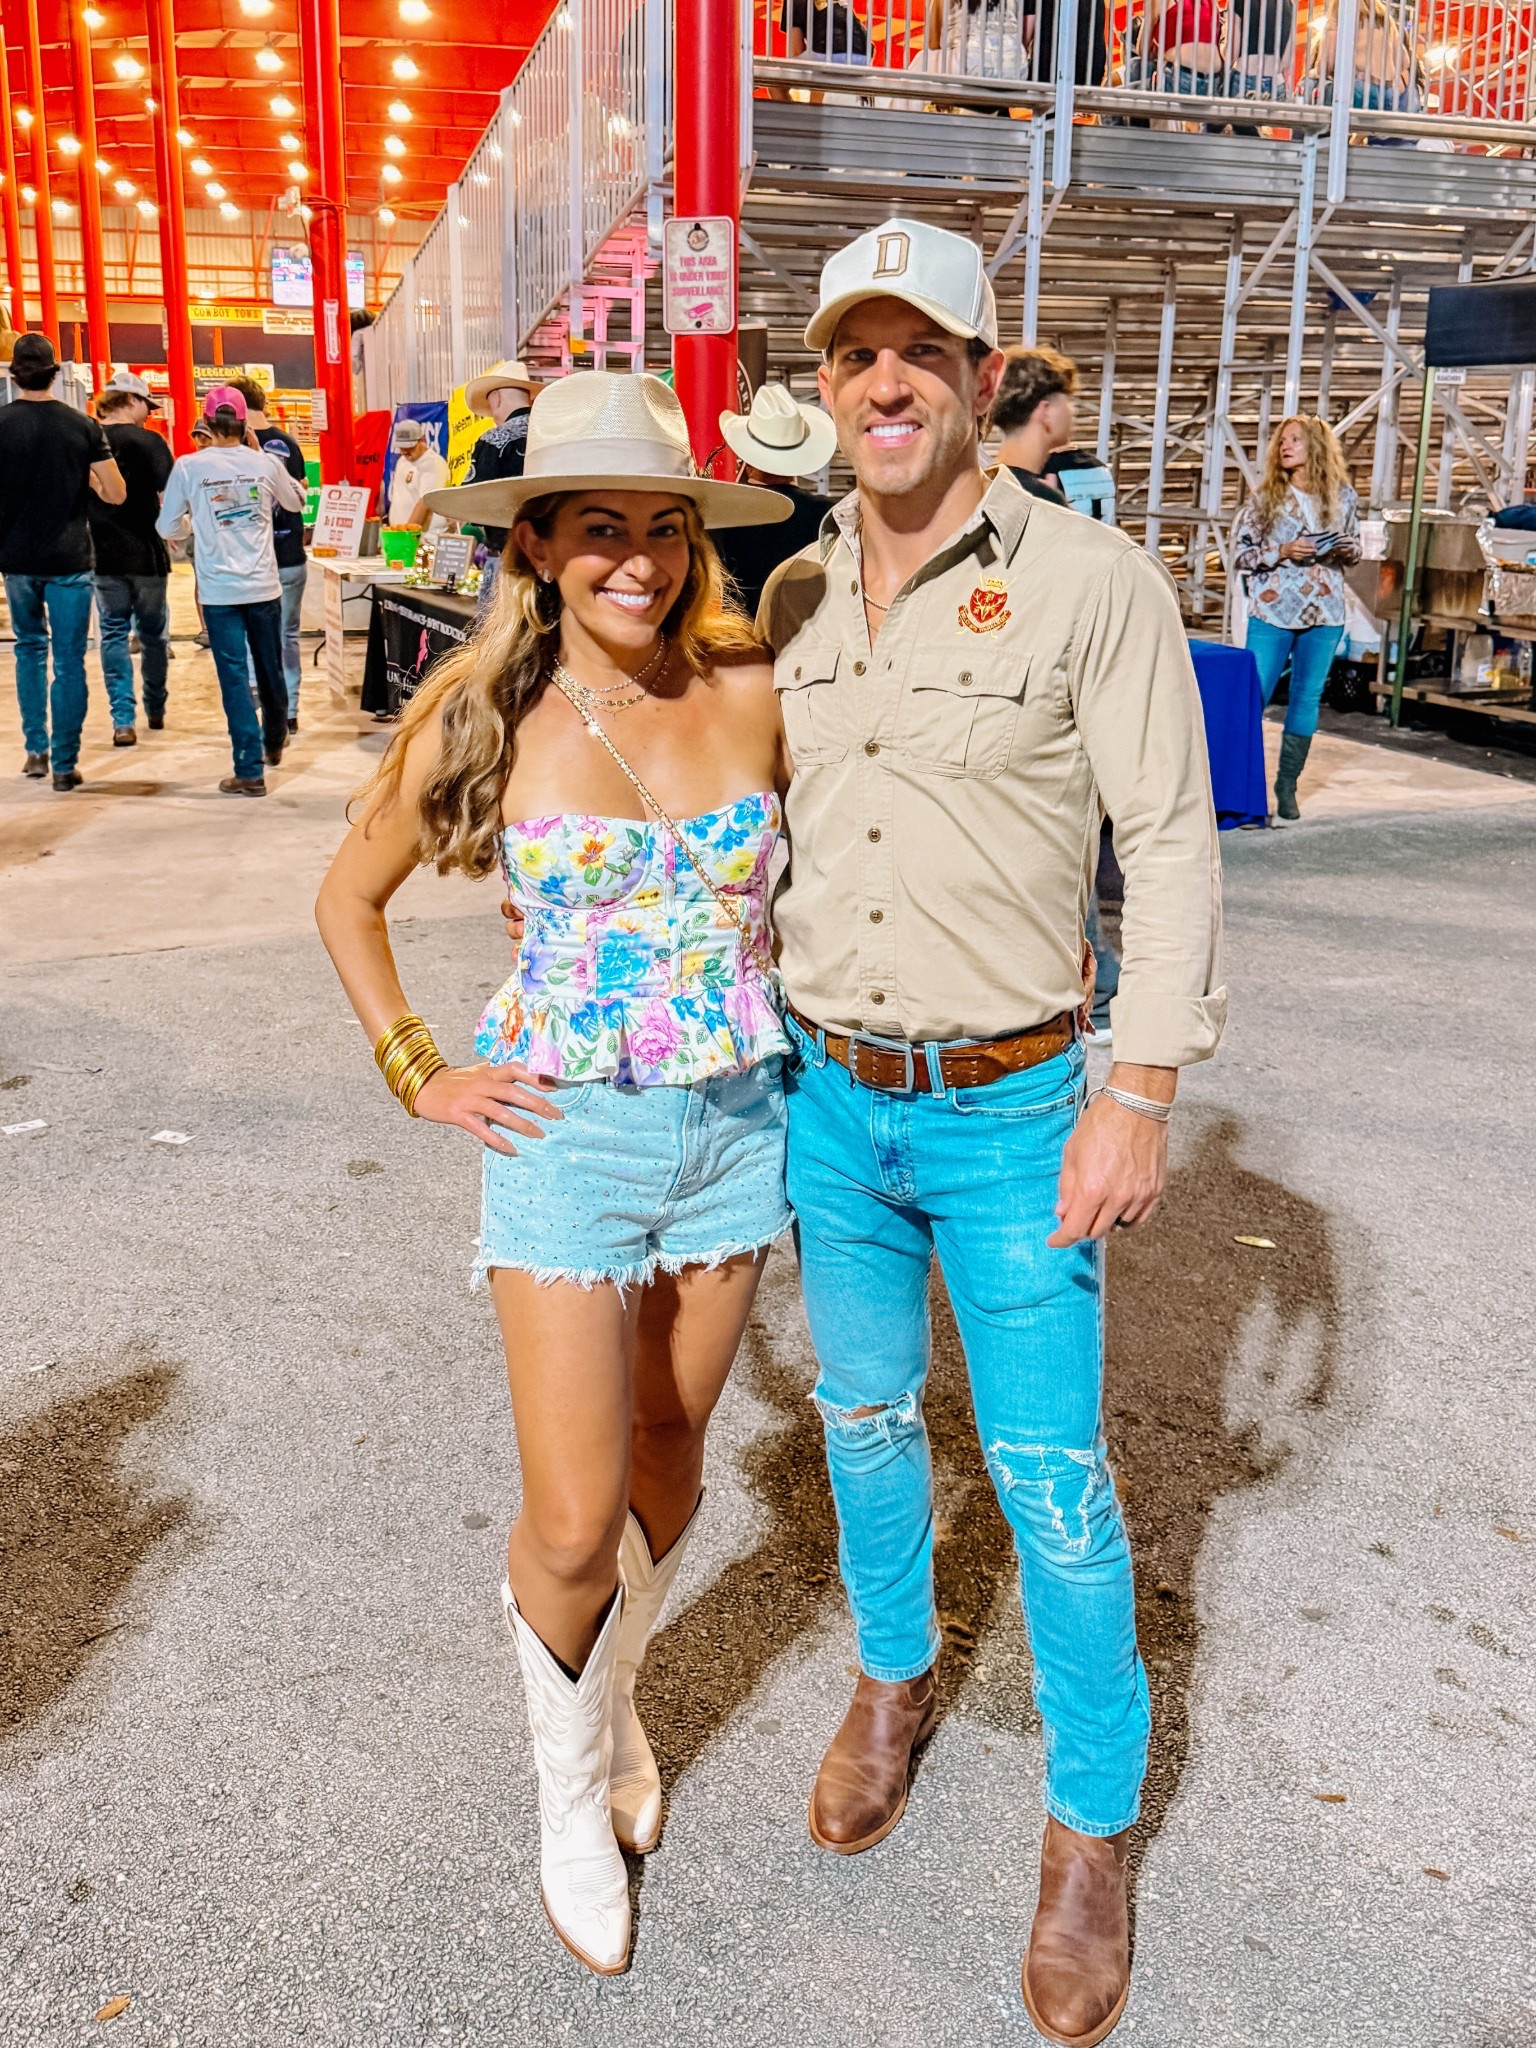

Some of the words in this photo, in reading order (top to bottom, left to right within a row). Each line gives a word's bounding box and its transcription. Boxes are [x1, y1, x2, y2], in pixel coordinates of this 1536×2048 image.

[872, 231, 910, 279] D
[680, 256, 696, 267] THIS
[698, 256, 718, 266] AREA
[670, 272, 677, 282] IS
[680, 271, 704, 281] UNDER
[706, 271, 727, 281] VIDEO
[672, 286, 724, 296] SURVEILLANCE
